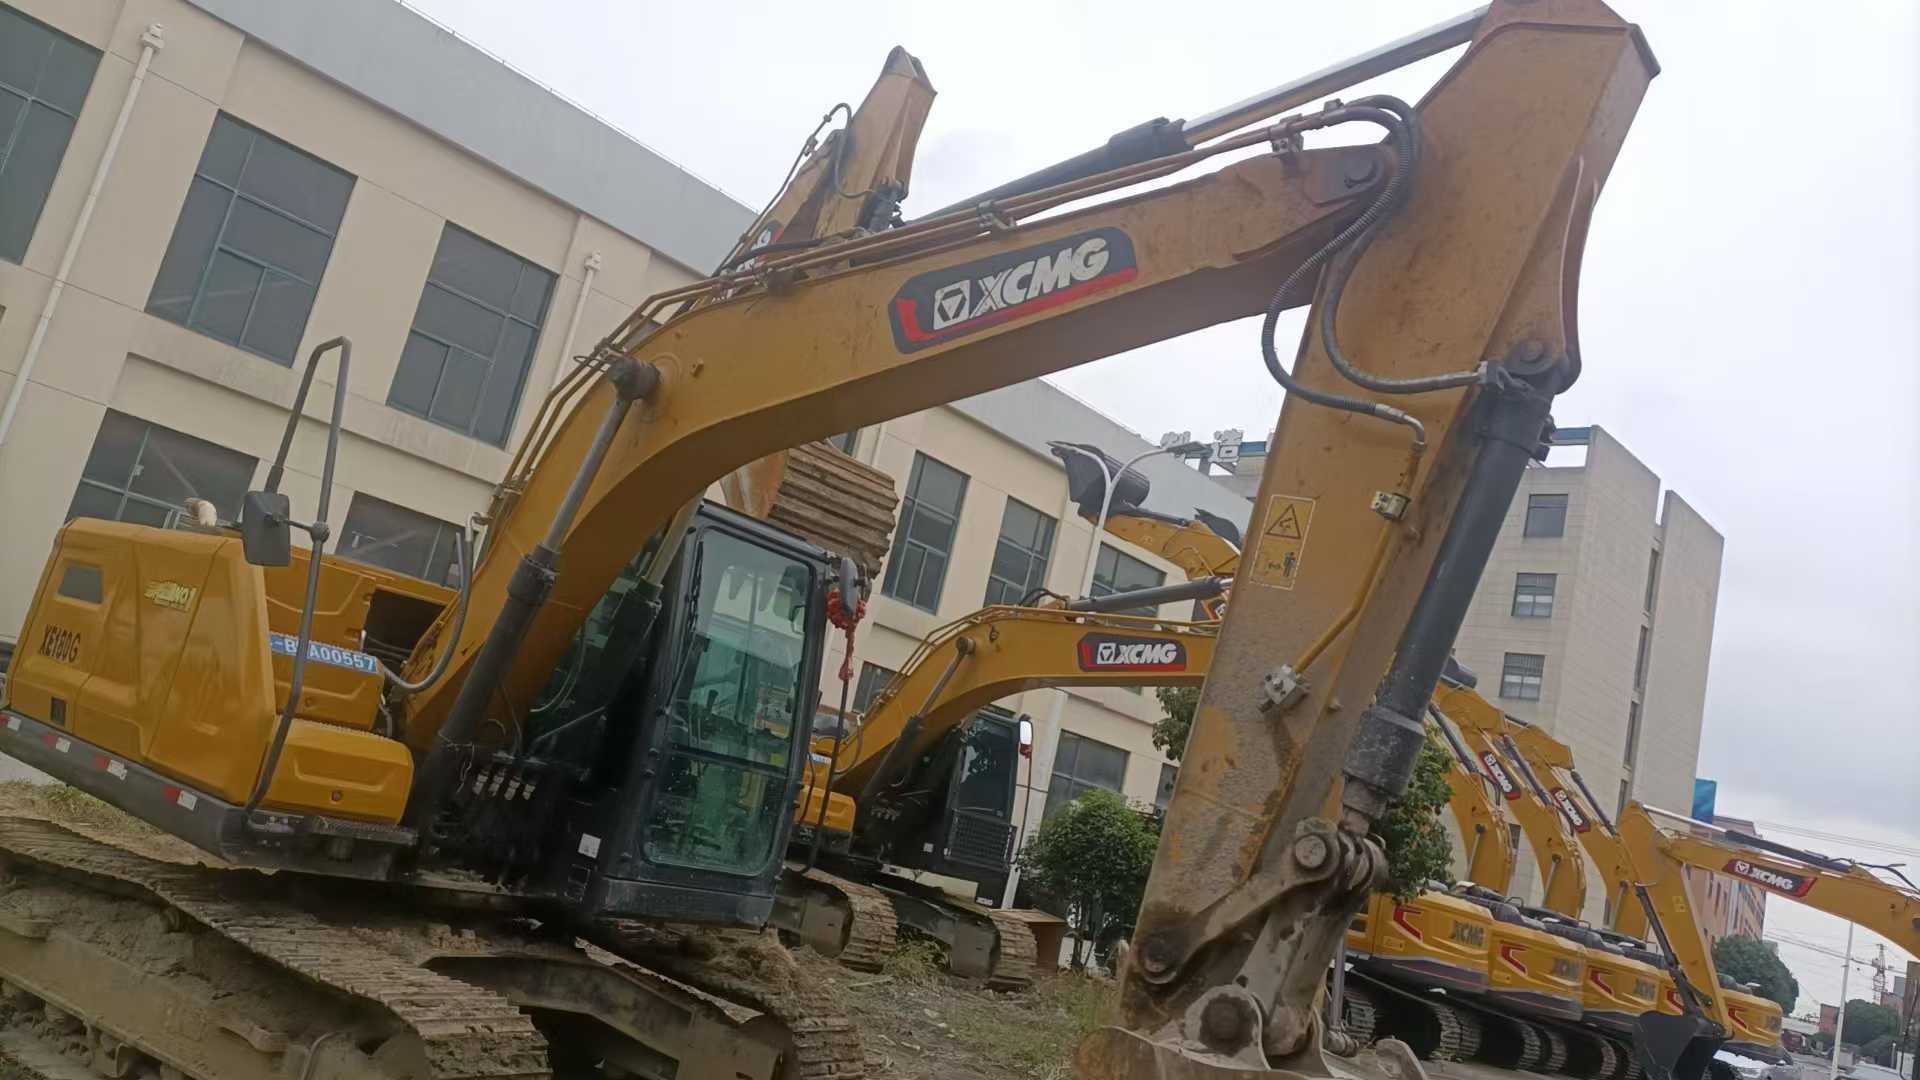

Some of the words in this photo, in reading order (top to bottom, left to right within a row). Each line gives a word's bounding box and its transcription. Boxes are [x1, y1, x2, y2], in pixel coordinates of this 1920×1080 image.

[969, 237, 1110, 319] XCMG
[1116, 642, 1177, 665] XCMG
[1490, 762, 1513, 793] XCMG
[1561, 797, 1584, 827] XCMG
[1751, 867, 1794, 890] XCMG
